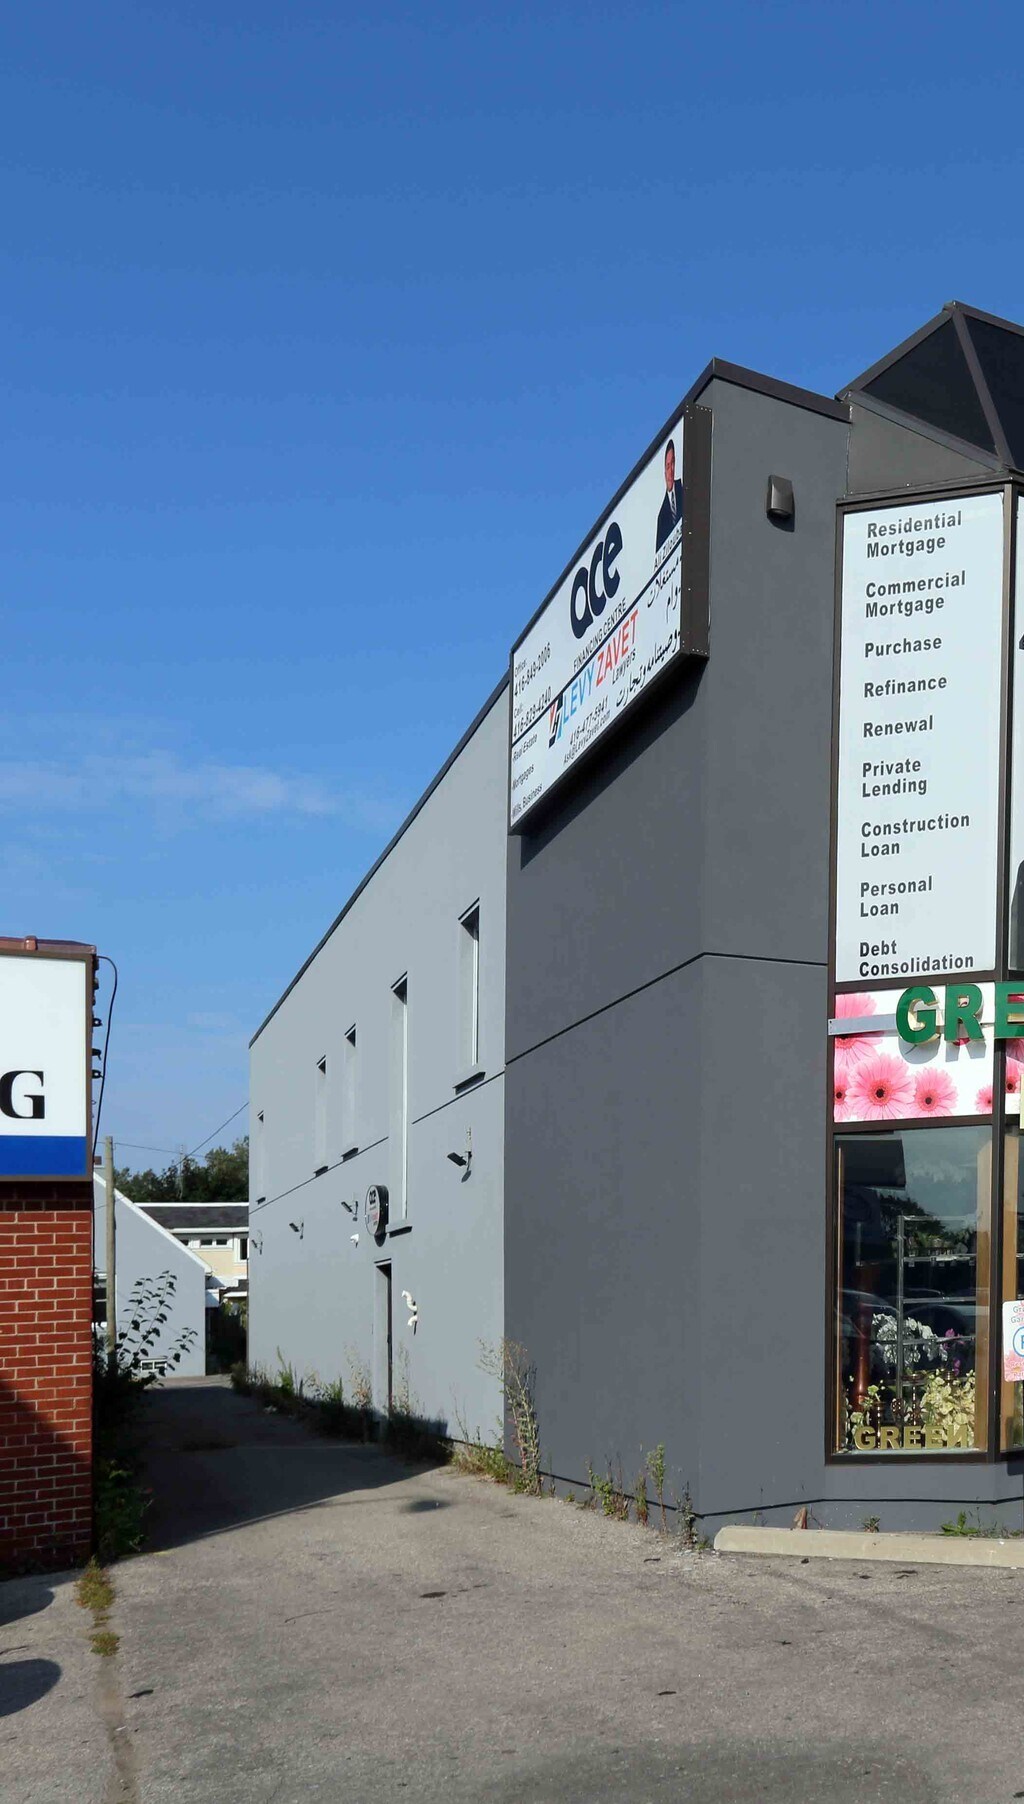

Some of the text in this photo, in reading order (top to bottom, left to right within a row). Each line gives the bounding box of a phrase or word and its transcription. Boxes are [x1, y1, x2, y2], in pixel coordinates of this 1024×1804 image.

[867, 511, 962, 538] Residential
[867, 536, 946, 558] Mortgage
[571, 522, 623, 639] ace
[866, 570, 966, 598] Commercial
[865, 597, 945, 618] Mortgage
[573, 598, 627, 673] FINANCING CENTRE
[864, 637, 942, 658] Purchase
[514, 642, 551, 697] 416-849-2006
[563, 610, 639, 725] LEVY ZAVET
[612, 648, 636, 686] Lawyers
[864, 676, 948, 698] Refinance
[513, 686, 552, 738] 416-829-4240
[863, 715, 934, 738] Renewal
[862, 758, 921, 778] Private
[862, 778, 927, 798] Lending
[861, 813, 970, 837] Construction
[861, 841, 900, 858] Loan
[860, 875, 933, 897] Personal
[860, 902, 899, 917] Loan
[859, 940, 897, 957] Debt
[859, 954, 974, 977] Consolidation
[855, 1425, 968, 1450] GREEN
